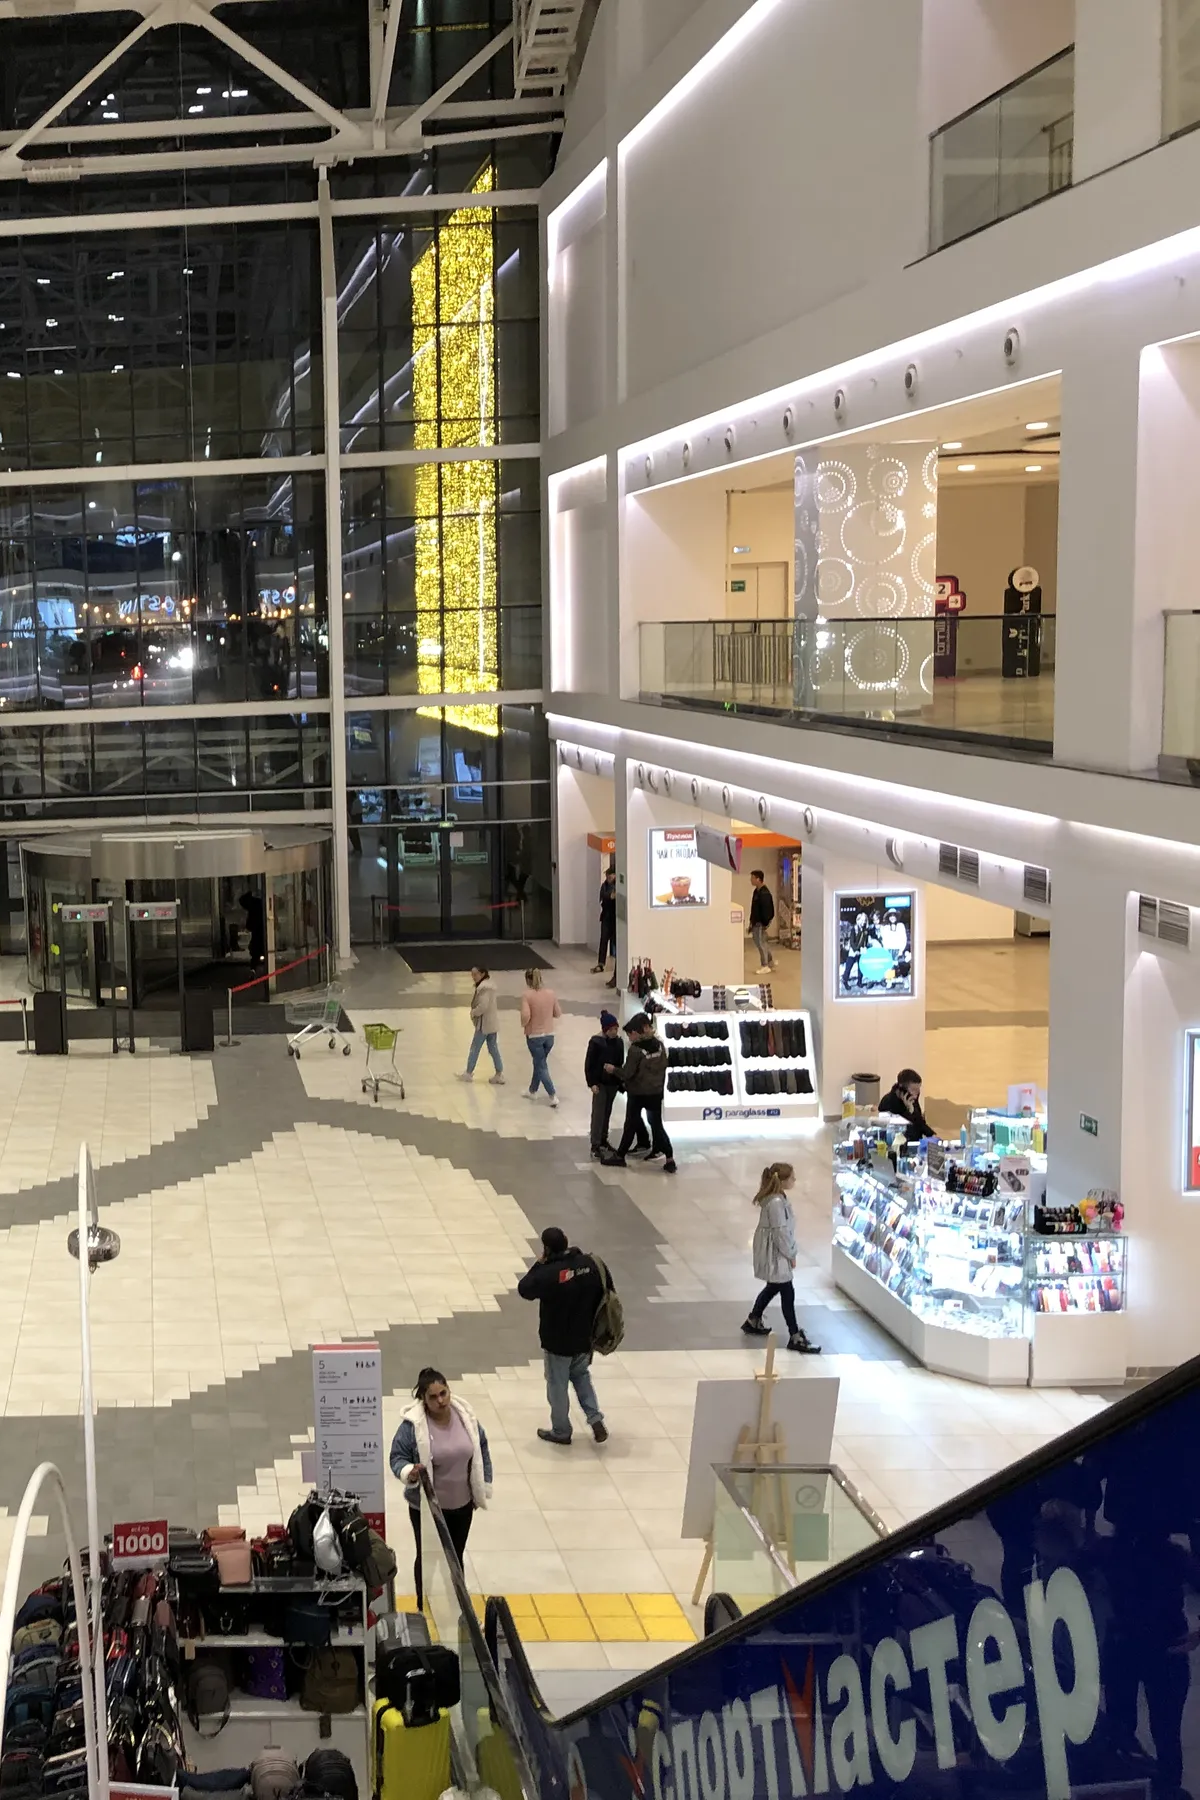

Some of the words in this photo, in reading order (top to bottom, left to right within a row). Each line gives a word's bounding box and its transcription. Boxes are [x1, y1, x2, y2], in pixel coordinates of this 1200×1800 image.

[938, 583, 946, 595] 2
[657, 849, 668, 859] ЧАЙ
[725, 1107, 766, 1118] paraglass
[319, 1360, 325, 1370] 5
[320, 1395, 326, 1404] 4
[322, 1441, 328, 1450] 3
[116, 1532, 164, 1553] 1000
